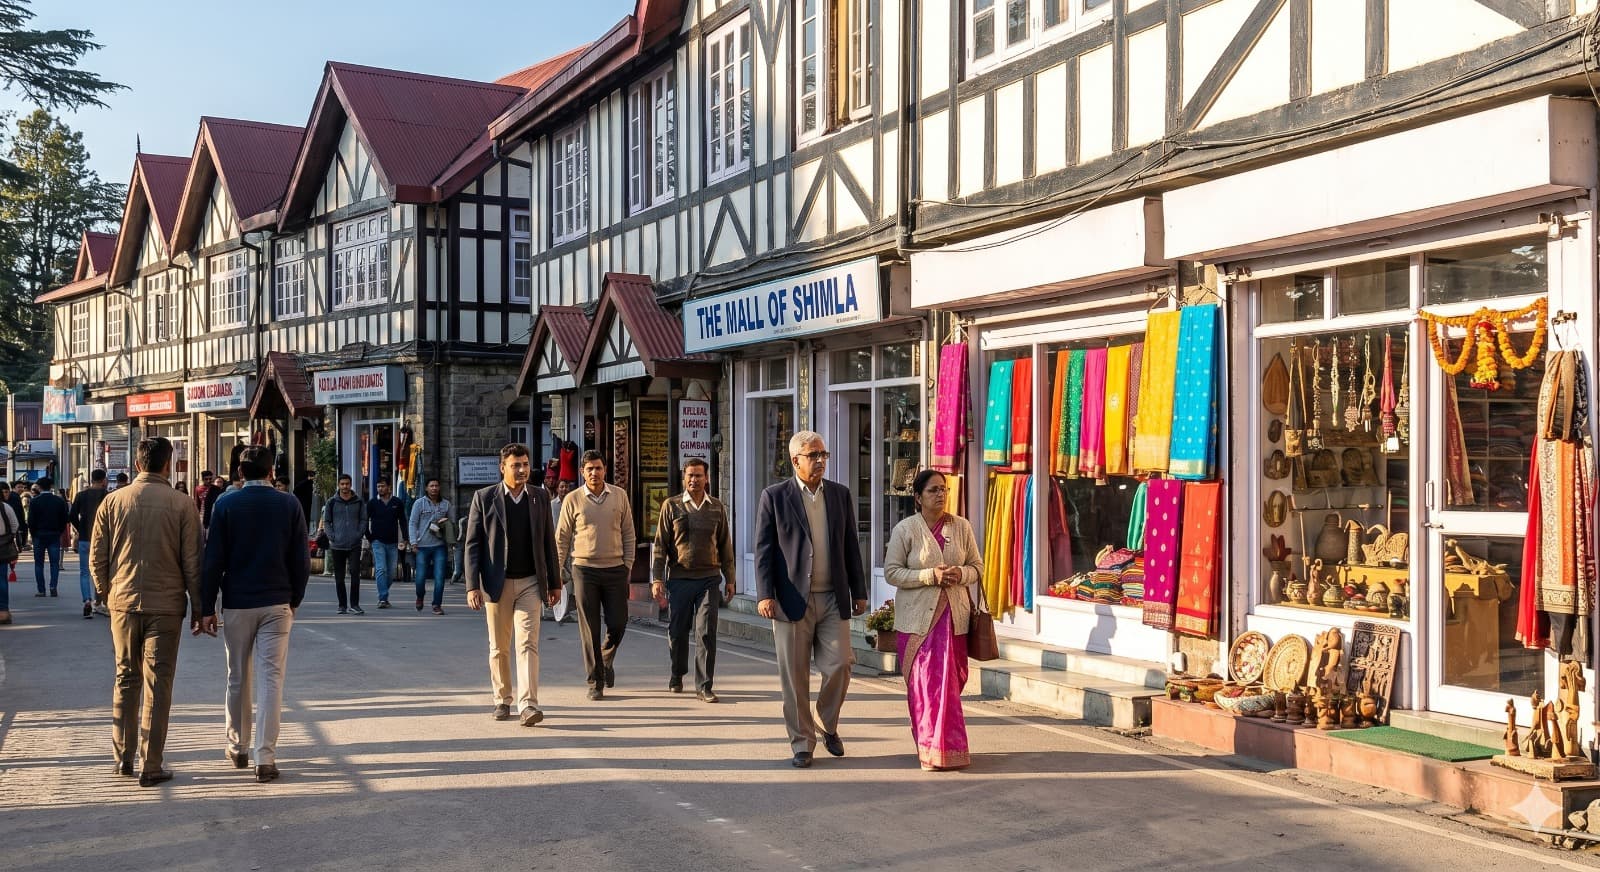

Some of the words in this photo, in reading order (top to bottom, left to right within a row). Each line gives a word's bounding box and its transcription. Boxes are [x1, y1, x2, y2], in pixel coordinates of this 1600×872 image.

[697, 303, 723, 340] THE
[726, 295, 765, 335] MALL
[768, 288, 787, 327] OF
[792, 273, 859, 323] SHIMLA
